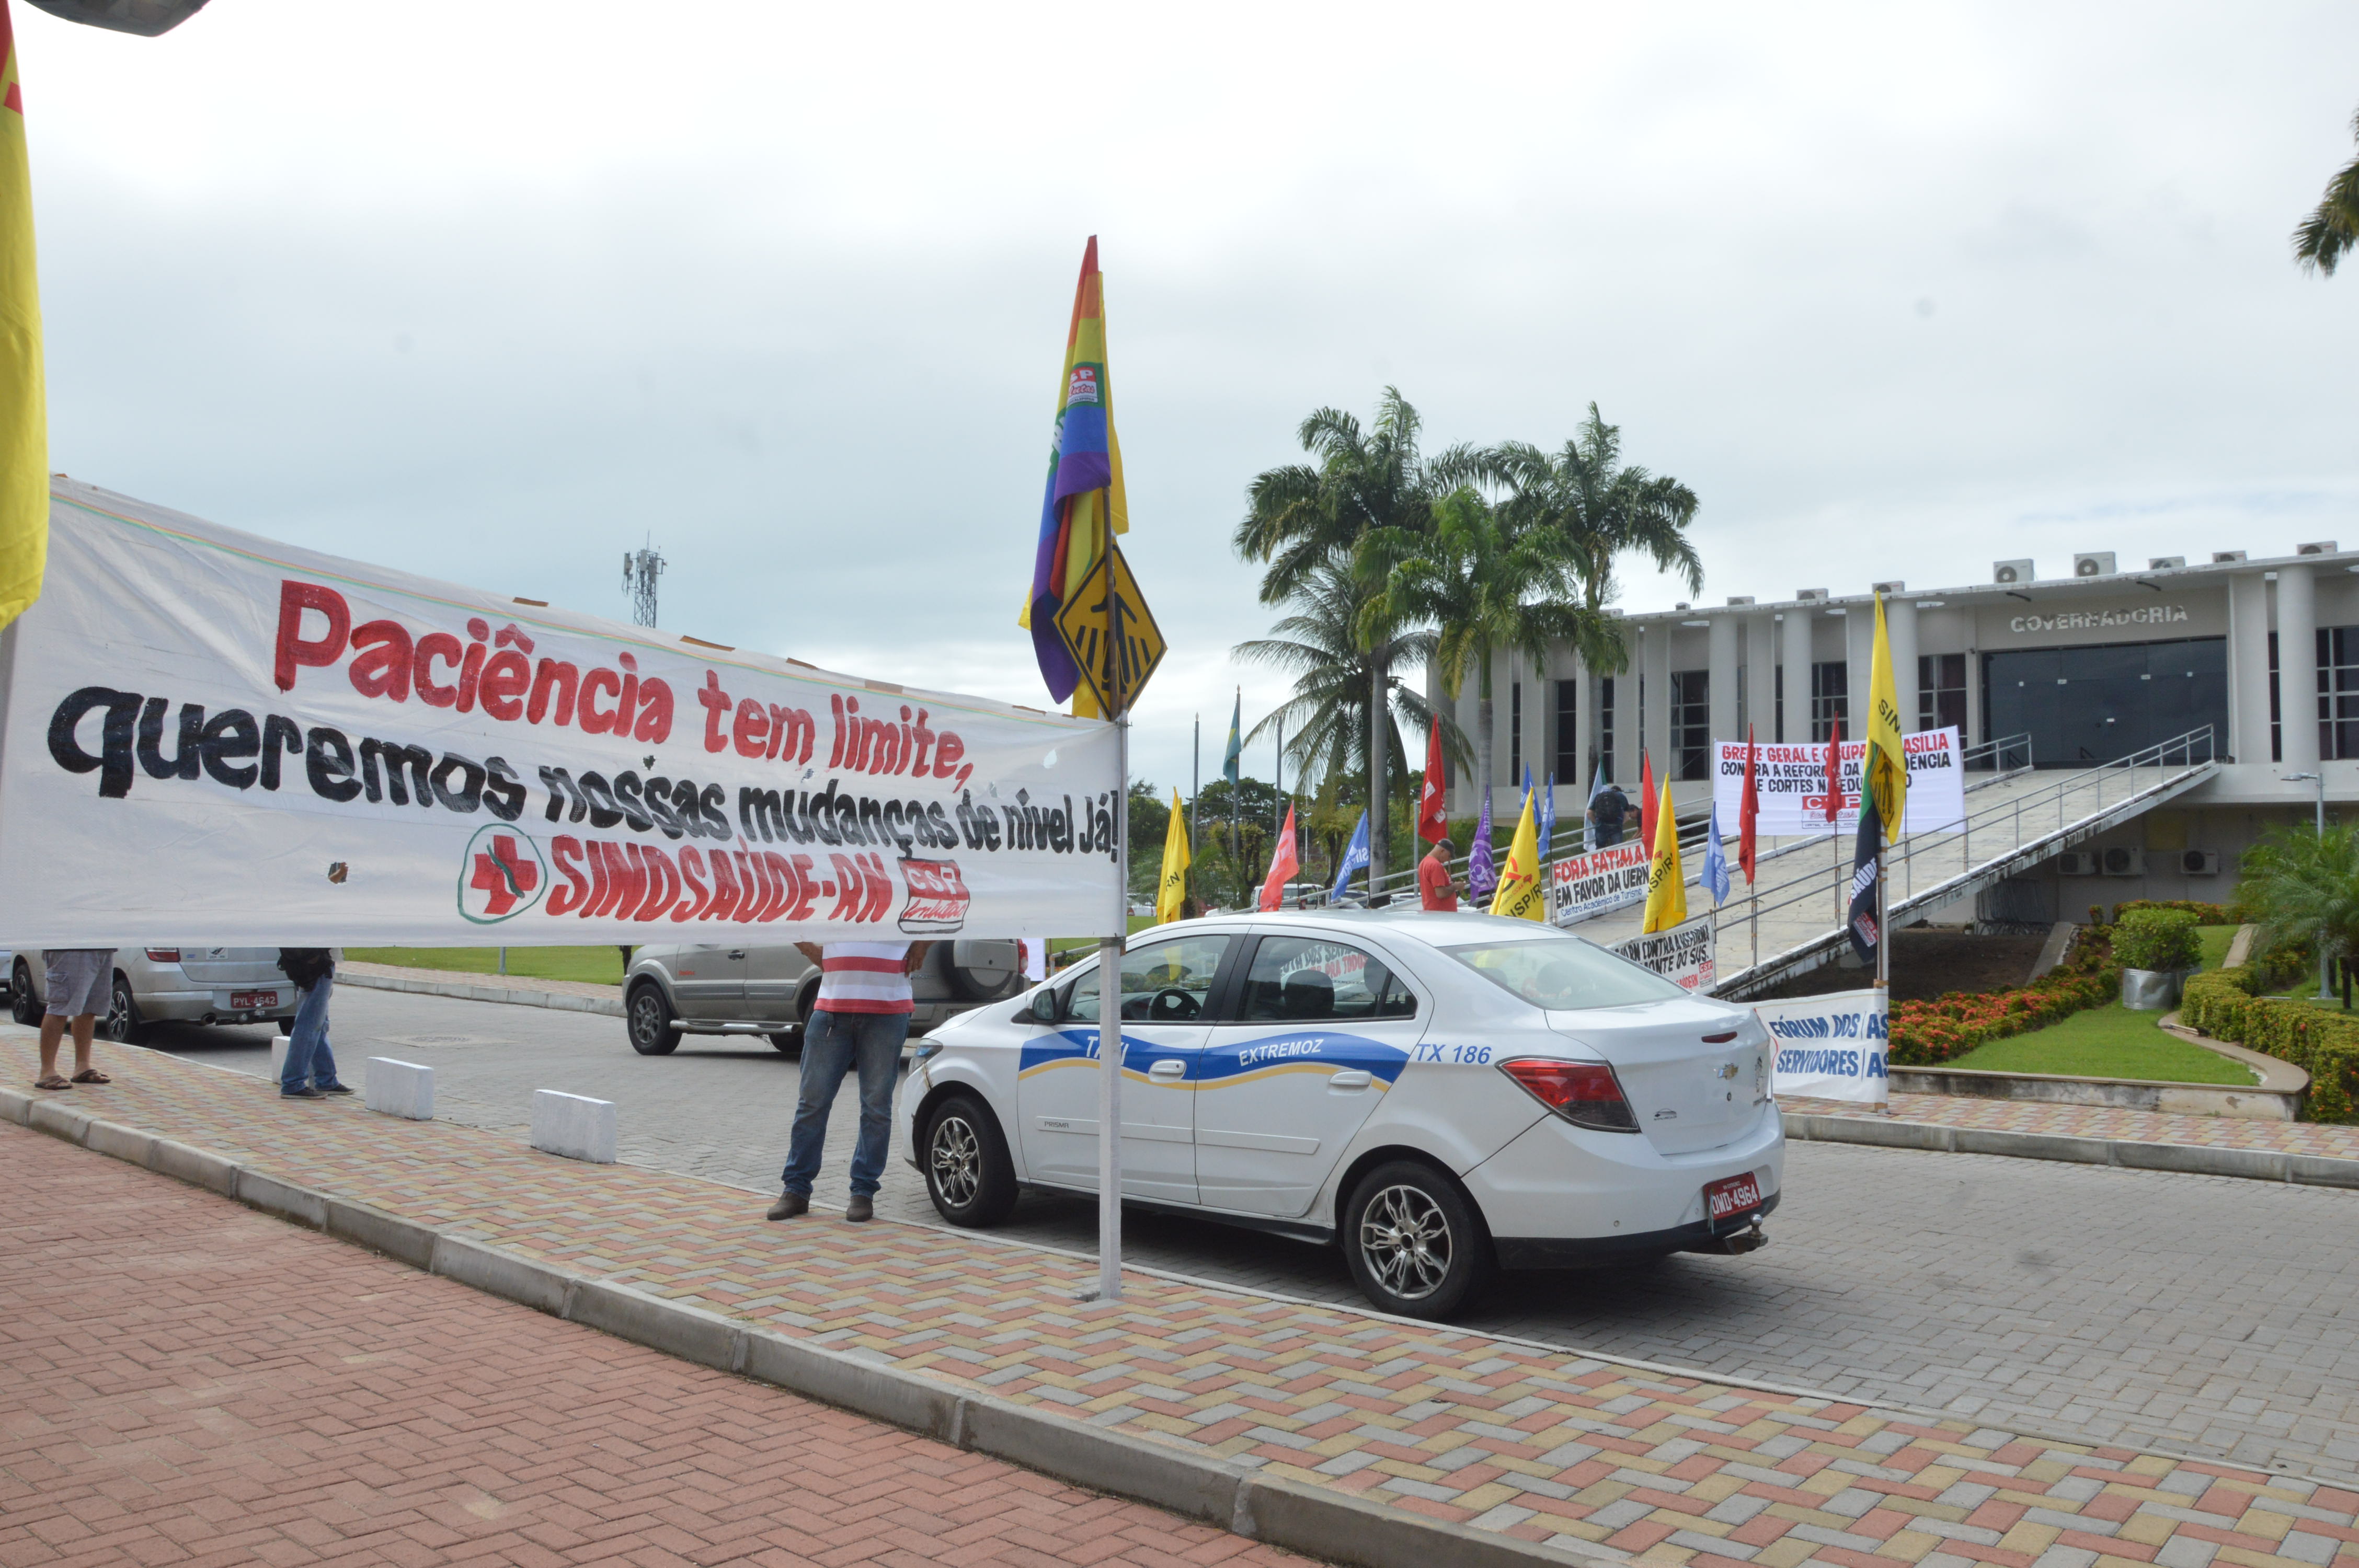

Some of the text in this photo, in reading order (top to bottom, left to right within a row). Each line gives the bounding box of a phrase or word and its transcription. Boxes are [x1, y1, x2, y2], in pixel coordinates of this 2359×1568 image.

[2011, 605, 2188, 632] GOVERNADORIA
[274, 579, 973, 793] Paciência tem limite,
[1879, 699, 1902, 739] SIN
[1722, 746, 1762, 761] GREE
[1767, 747, 1809, 763] GERAL
[1812, 747, 1819, 763] E
[48, 686, 527, 822] queremos
[538, 766, 733, 841] nossas
[739, 779, 960, 858] mudanças
[956, 789, 1002, 852] de
[1721, 762, 1769, 777] CONRA
[1773, 764, 1781, 777] A
[1783, 765, 1827, 777] REFOR
[1844, 762, 1860, 776] DA
[1768, 779, 1813, 792] CORTES
[1818, 779, 1828, 792] N
[1806, 796, 1861, 809] CP
[907, 866, 957, 895] CSP
[1554, 858, 1589, 885] FORA
[1556, 864, 1650, 908] EM FAVOR DA UERN
[1561, 906, 1583, 917] Centro
[1613, 894, 1620, 902] de
[1640, 944, 1709, 974] ONTE DO SUS.
[1642, 936, 1675, 959] CONTRA
[1769, 1013, 1860, 1039] FÓRUM DOS
[1086, 1036, 1129, 1066] TI
[1239, 1039, 1324, 1067] EXTREMOZ
[1417, 1044, 1492, 1065] TX 186
[1777, 1050, 1860, 1077] SERVIDORES
